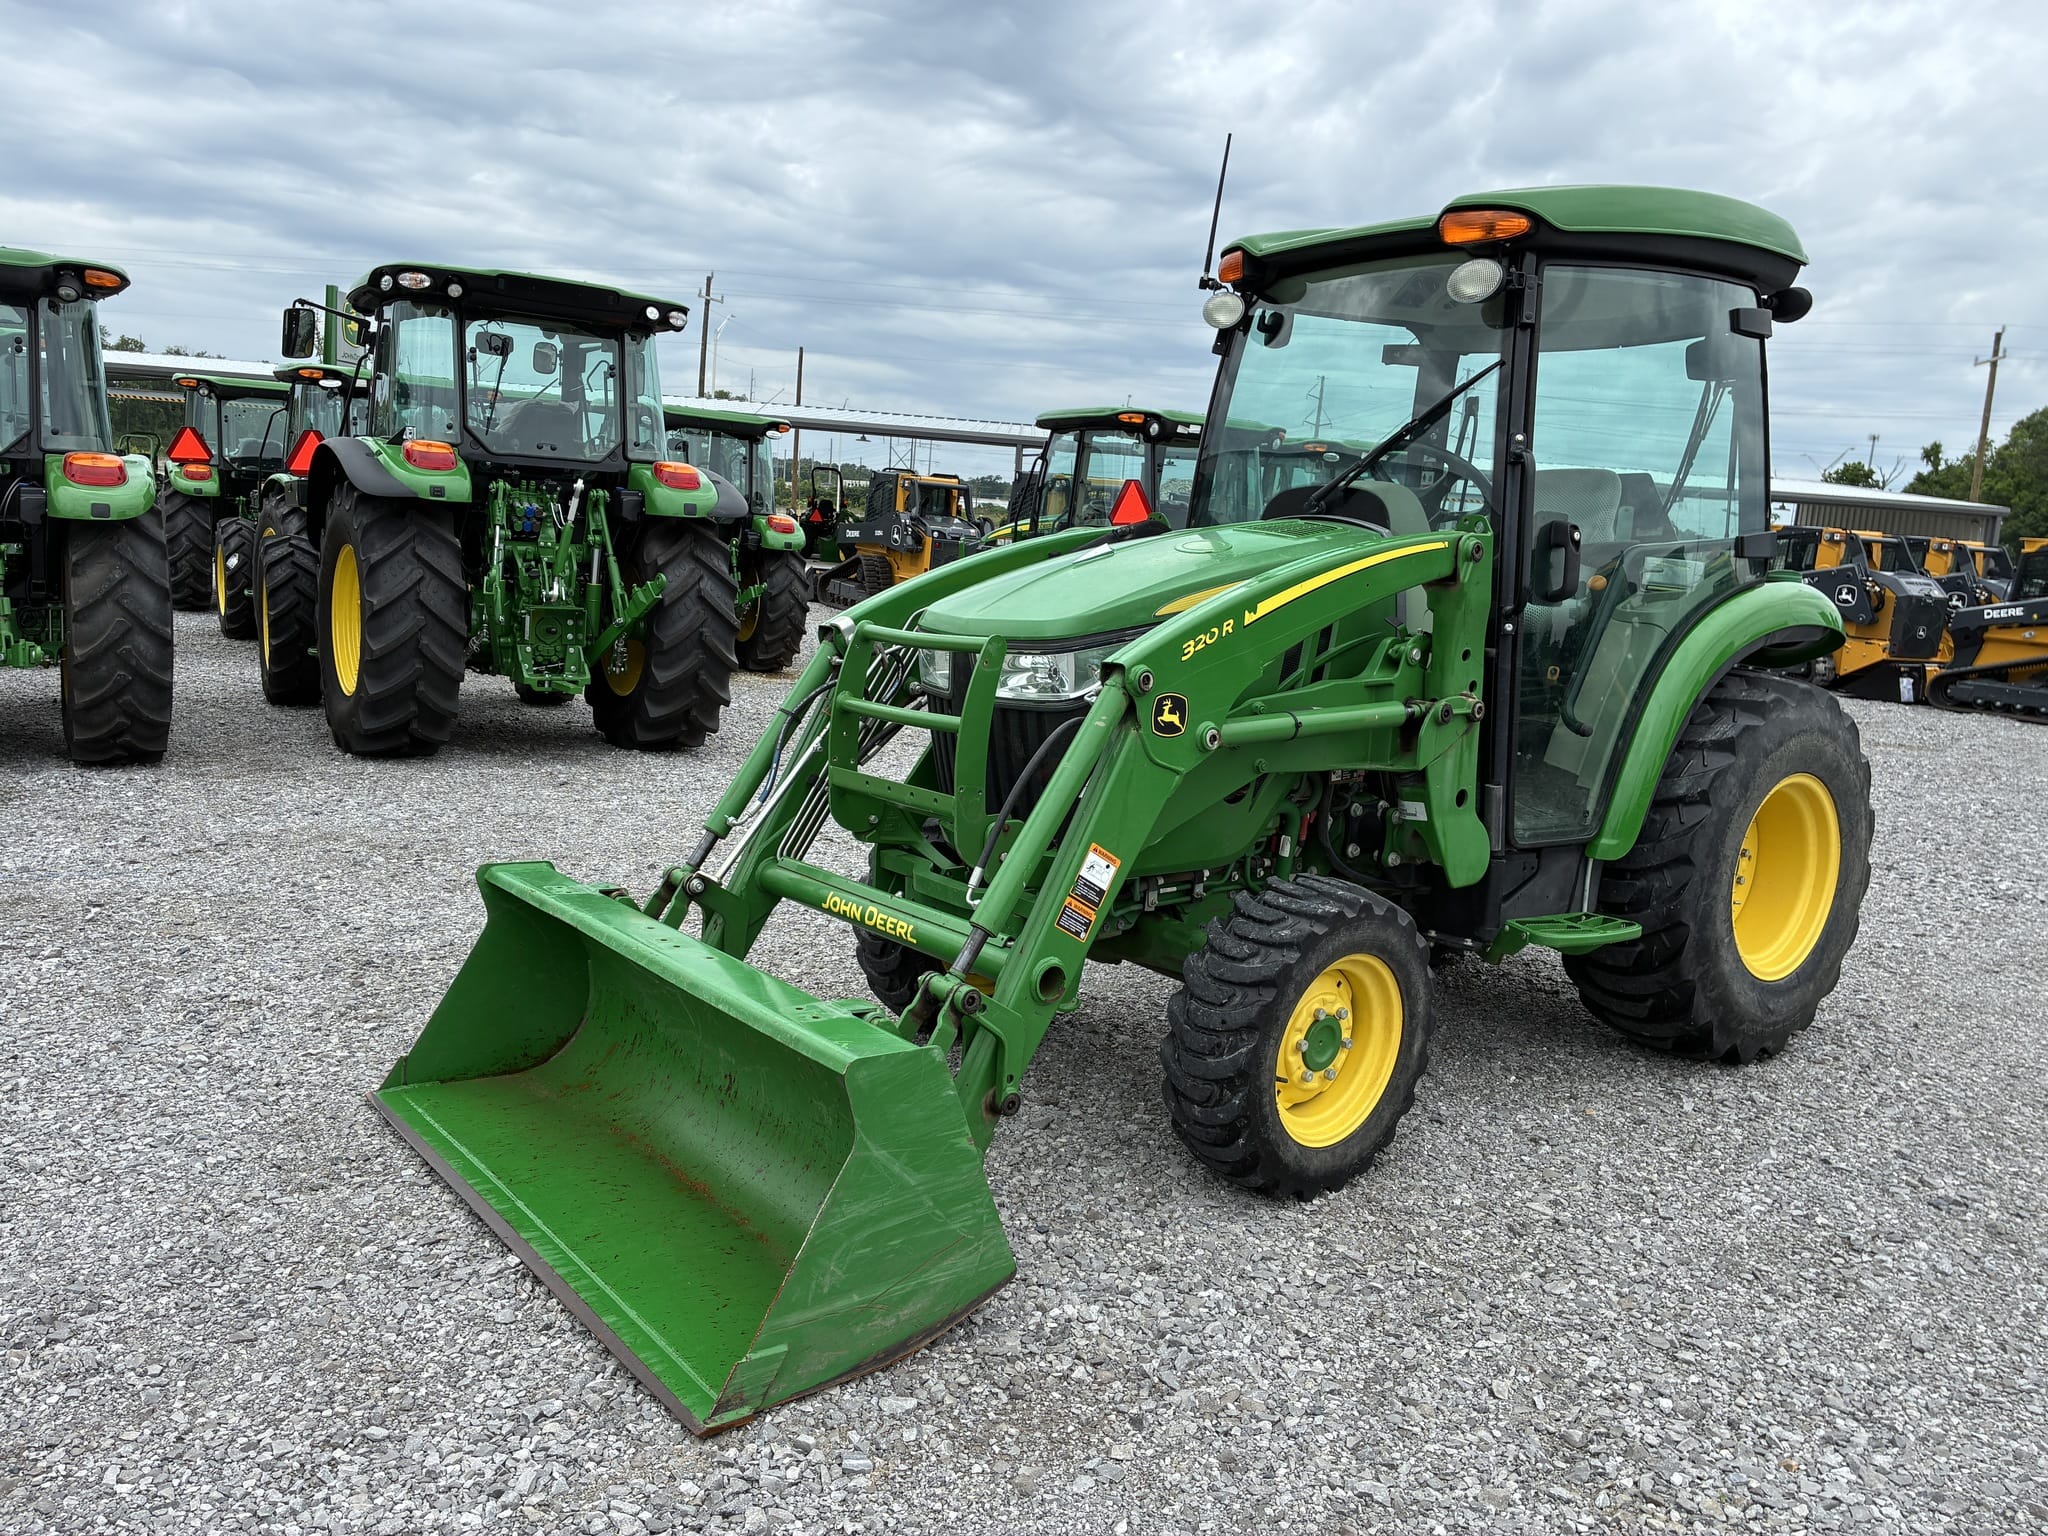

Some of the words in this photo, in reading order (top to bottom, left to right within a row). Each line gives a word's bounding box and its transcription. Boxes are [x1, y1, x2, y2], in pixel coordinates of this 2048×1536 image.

[1983, 606, 2024, 620] DEERE
[1181, 627, 1219, 661] 320
[1222, 618, 1234, 637] R
[822, 891, 863, 922] JOHN
